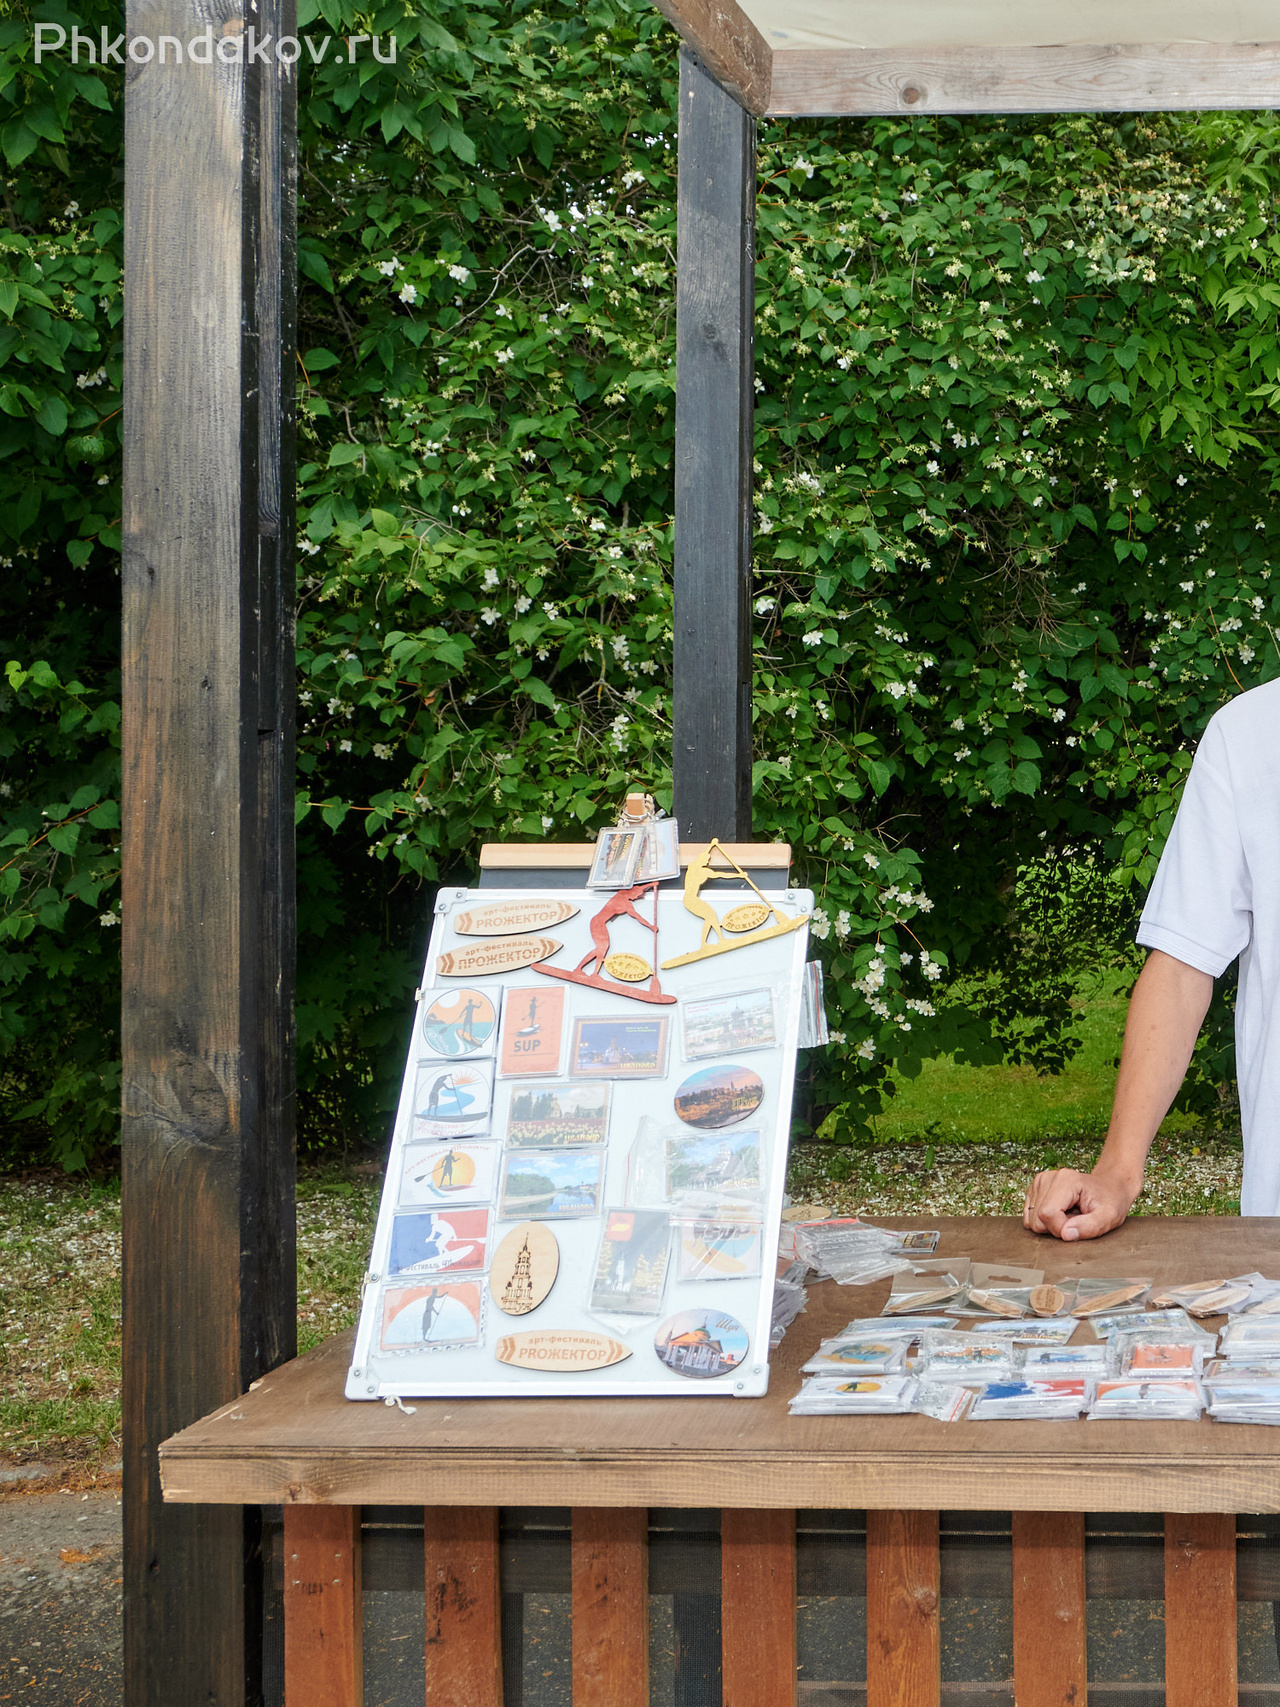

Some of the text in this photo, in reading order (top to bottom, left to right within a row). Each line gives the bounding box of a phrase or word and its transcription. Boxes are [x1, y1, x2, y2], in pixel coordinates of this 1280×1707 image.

[483, 903, 552, 917] арт-фестиваль
[465, 941, 535, 957] арт-фестиваль
[458, 947, 541, 970] ПРОЖЕКТОР
[513, 1039, 541, 1052] SUP
[528, 1336, 604, 1346] арт-фестиваль
[519, 1347, 607, 1361] PROЖЕКТОР
